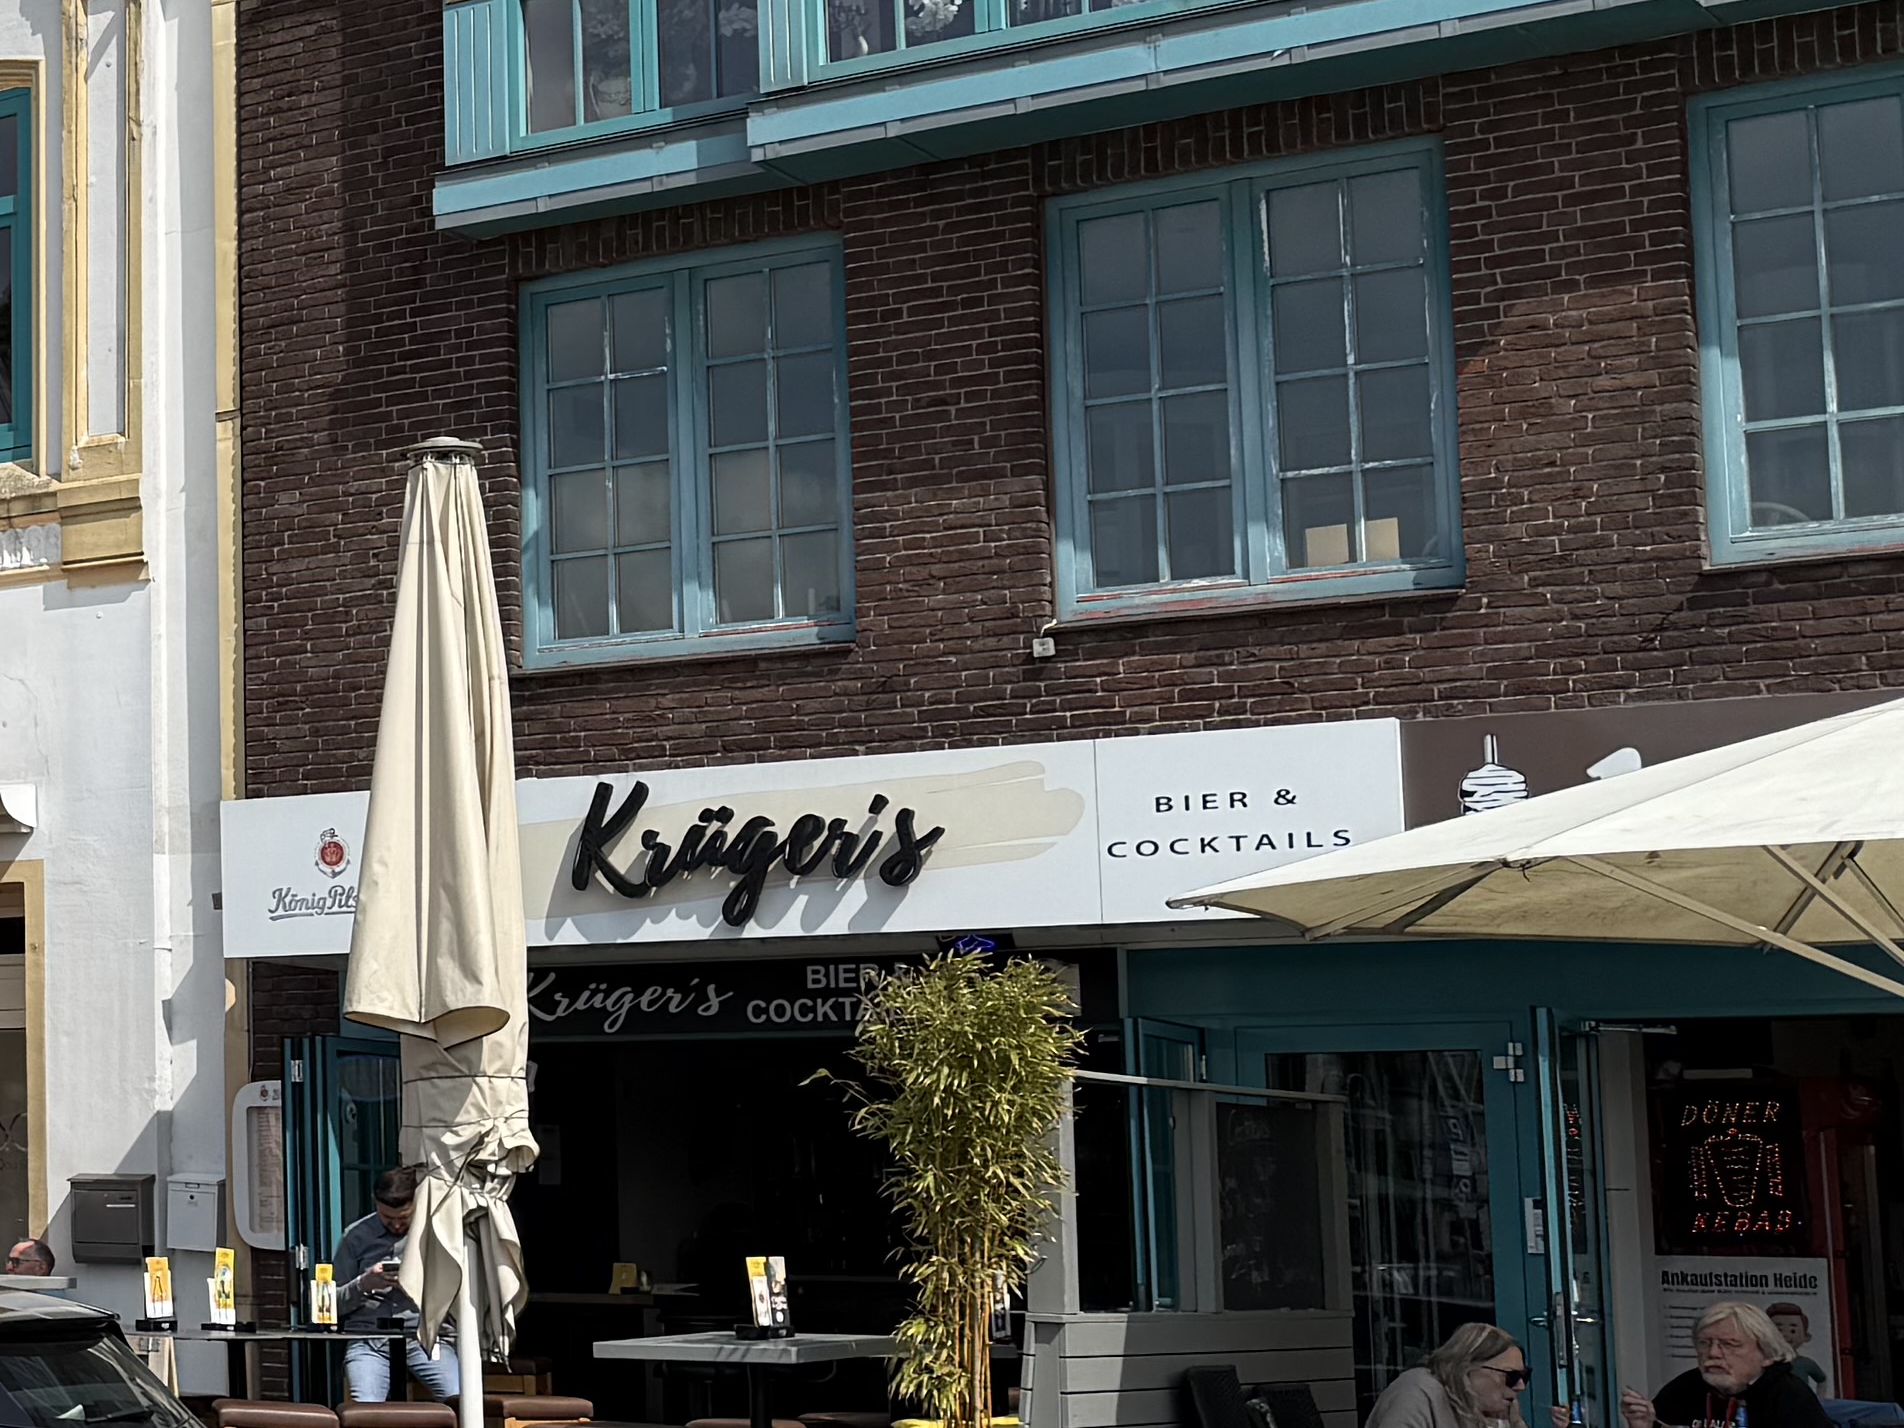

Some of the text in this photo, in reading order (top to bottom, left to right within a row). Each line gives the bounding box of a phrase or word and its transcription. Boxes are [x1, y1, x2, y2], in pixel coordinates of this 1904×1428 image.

[1155, 789, 1297, 813] BIER &
[1107, 829, 1352, 858] COCKTAILS
[326, 884, 359, 910] Pils
[1680, 1099, 1780, 1126] DÖNER
[1692, 1210, 1792, 1233] KEBAB
[1661, 1269, 1818, 1289] Ankaufstation Heide
